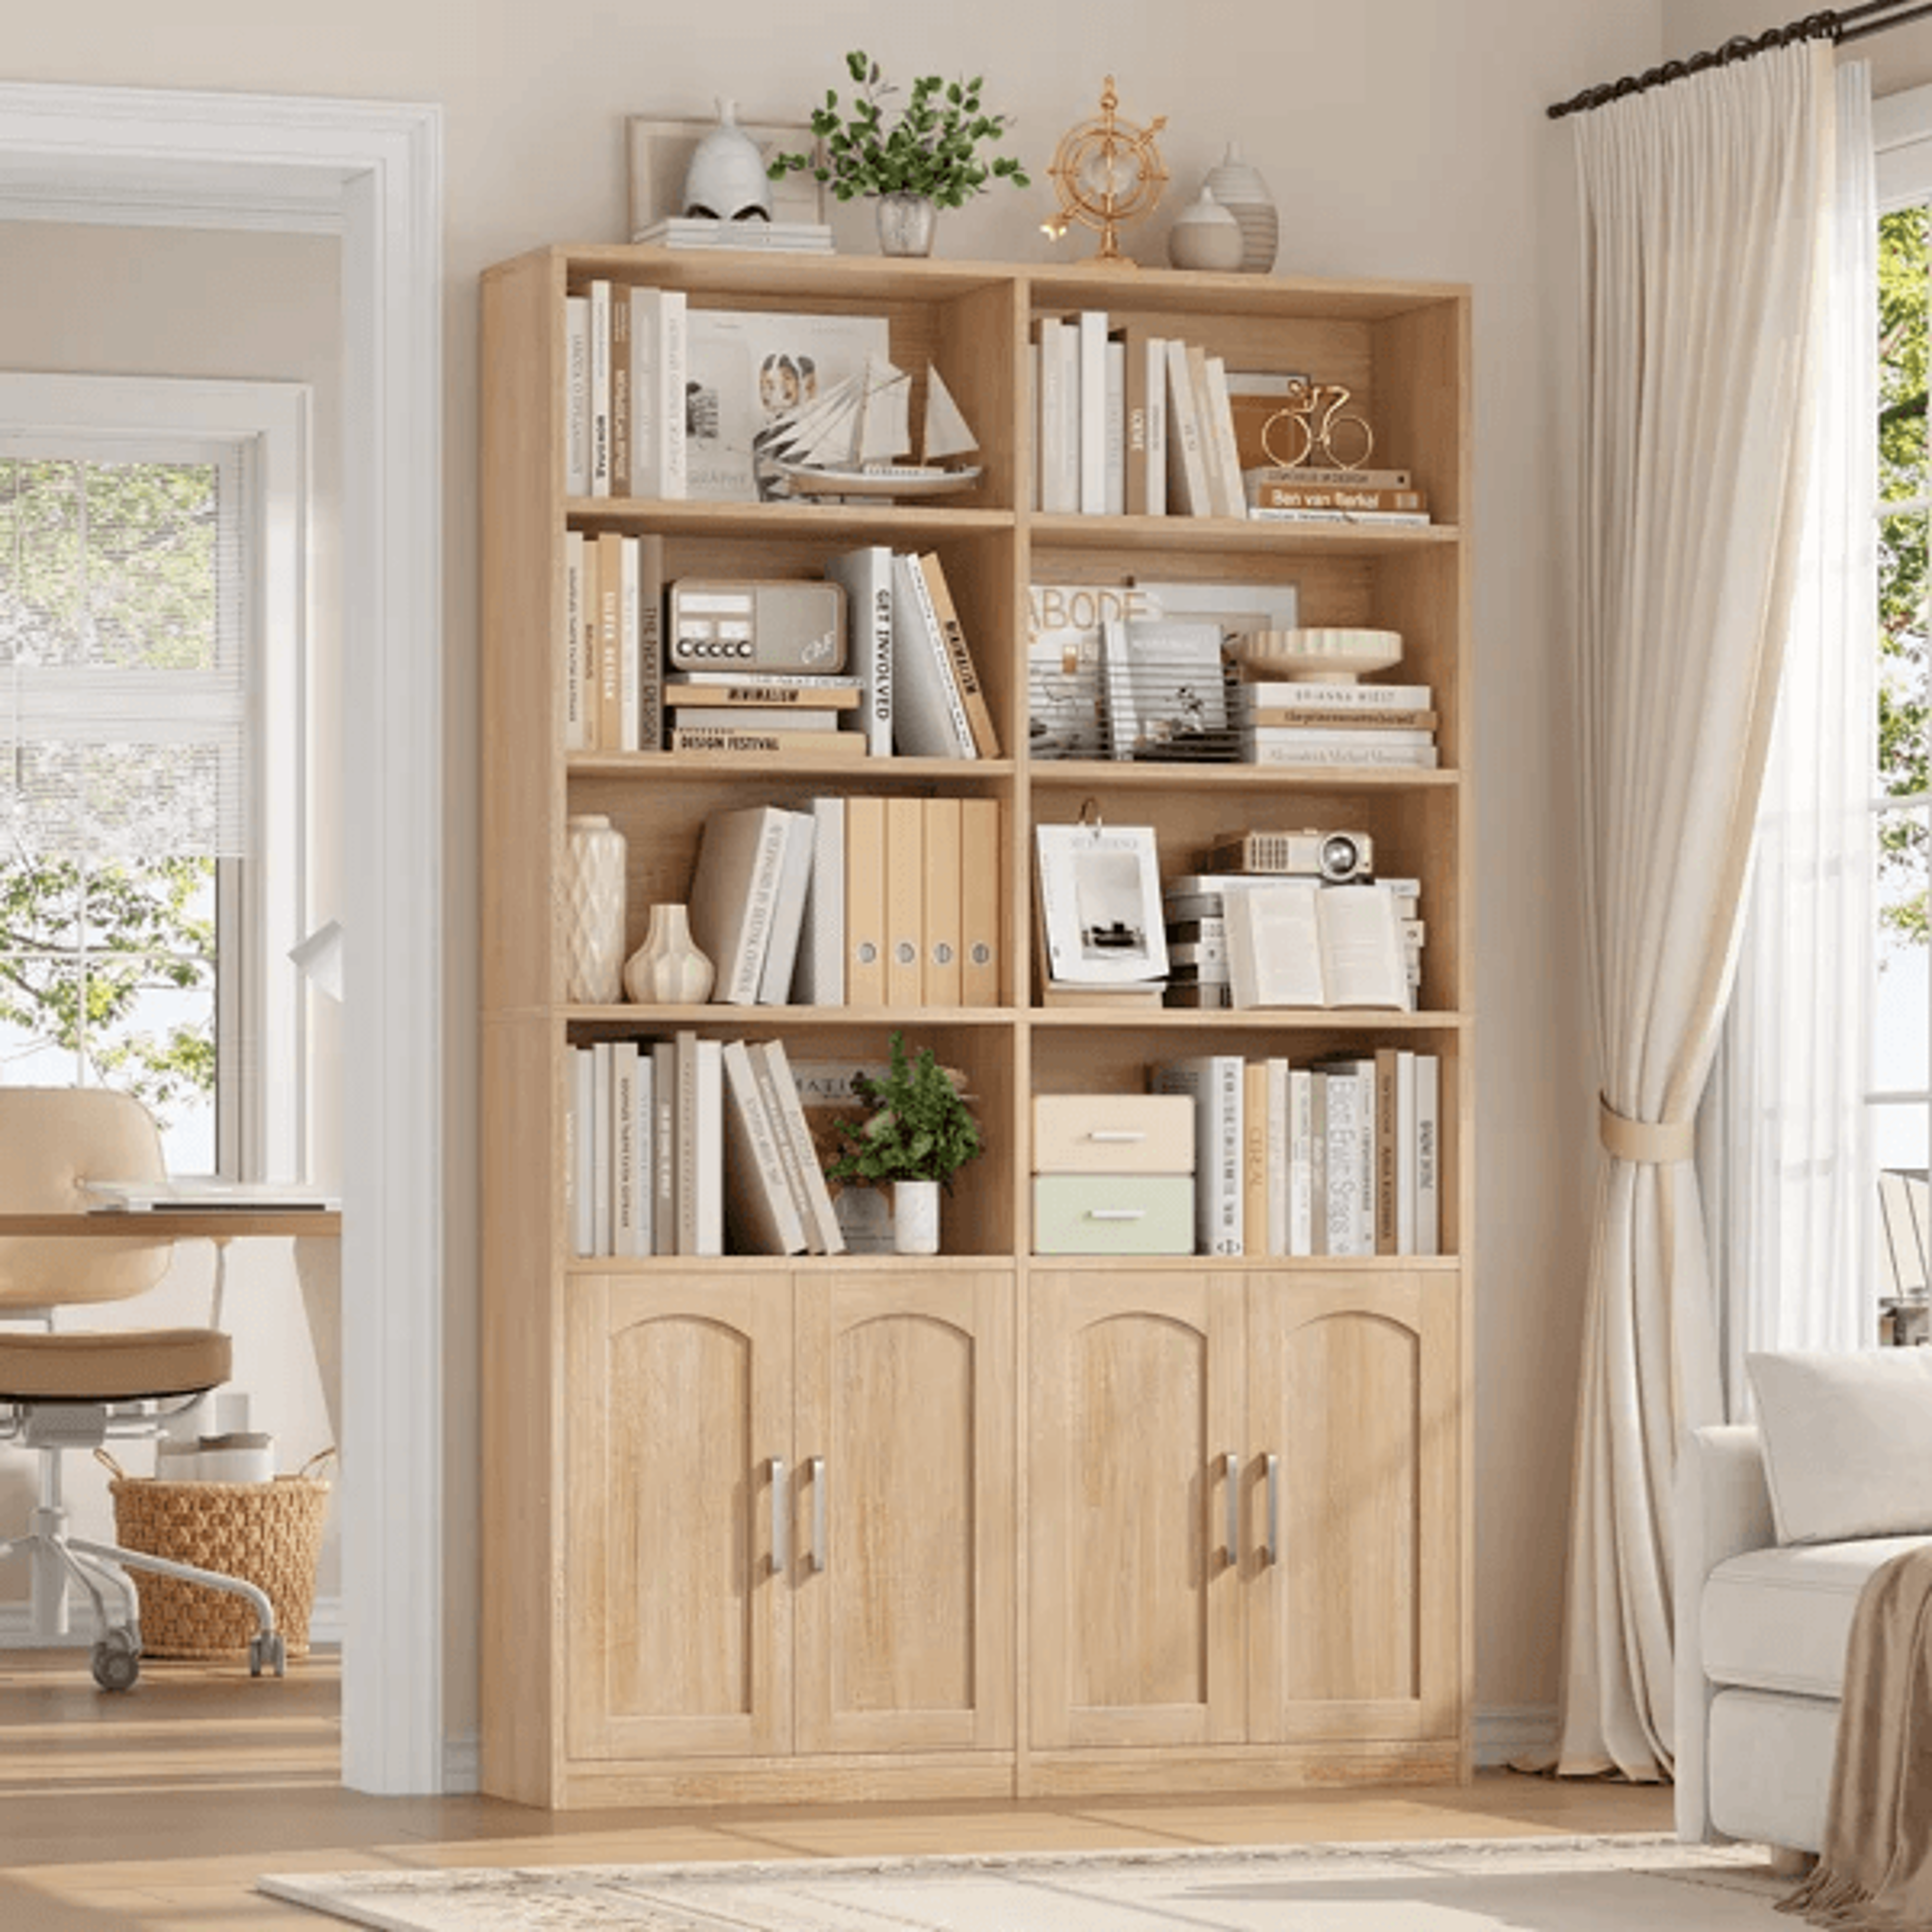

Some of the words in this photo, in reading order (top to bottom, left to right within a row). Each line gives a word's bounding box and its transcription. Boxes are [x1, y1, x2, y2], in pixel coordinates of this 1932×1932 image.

[1271, 489, 1301, 506] Ben
[1305, 493, 1331, 506] van
[645, 607, 657, 635] THE
[876, 589, 890, 622] GET
[645, 640, 657, 681] NEXT
[876, 630, 890, 721] INVOLVED
[645, 685, 657, 750] DESIGN
[680, 736, 725, 750] DESIGN
[728, 736, 779, 751] FESTIVAL
